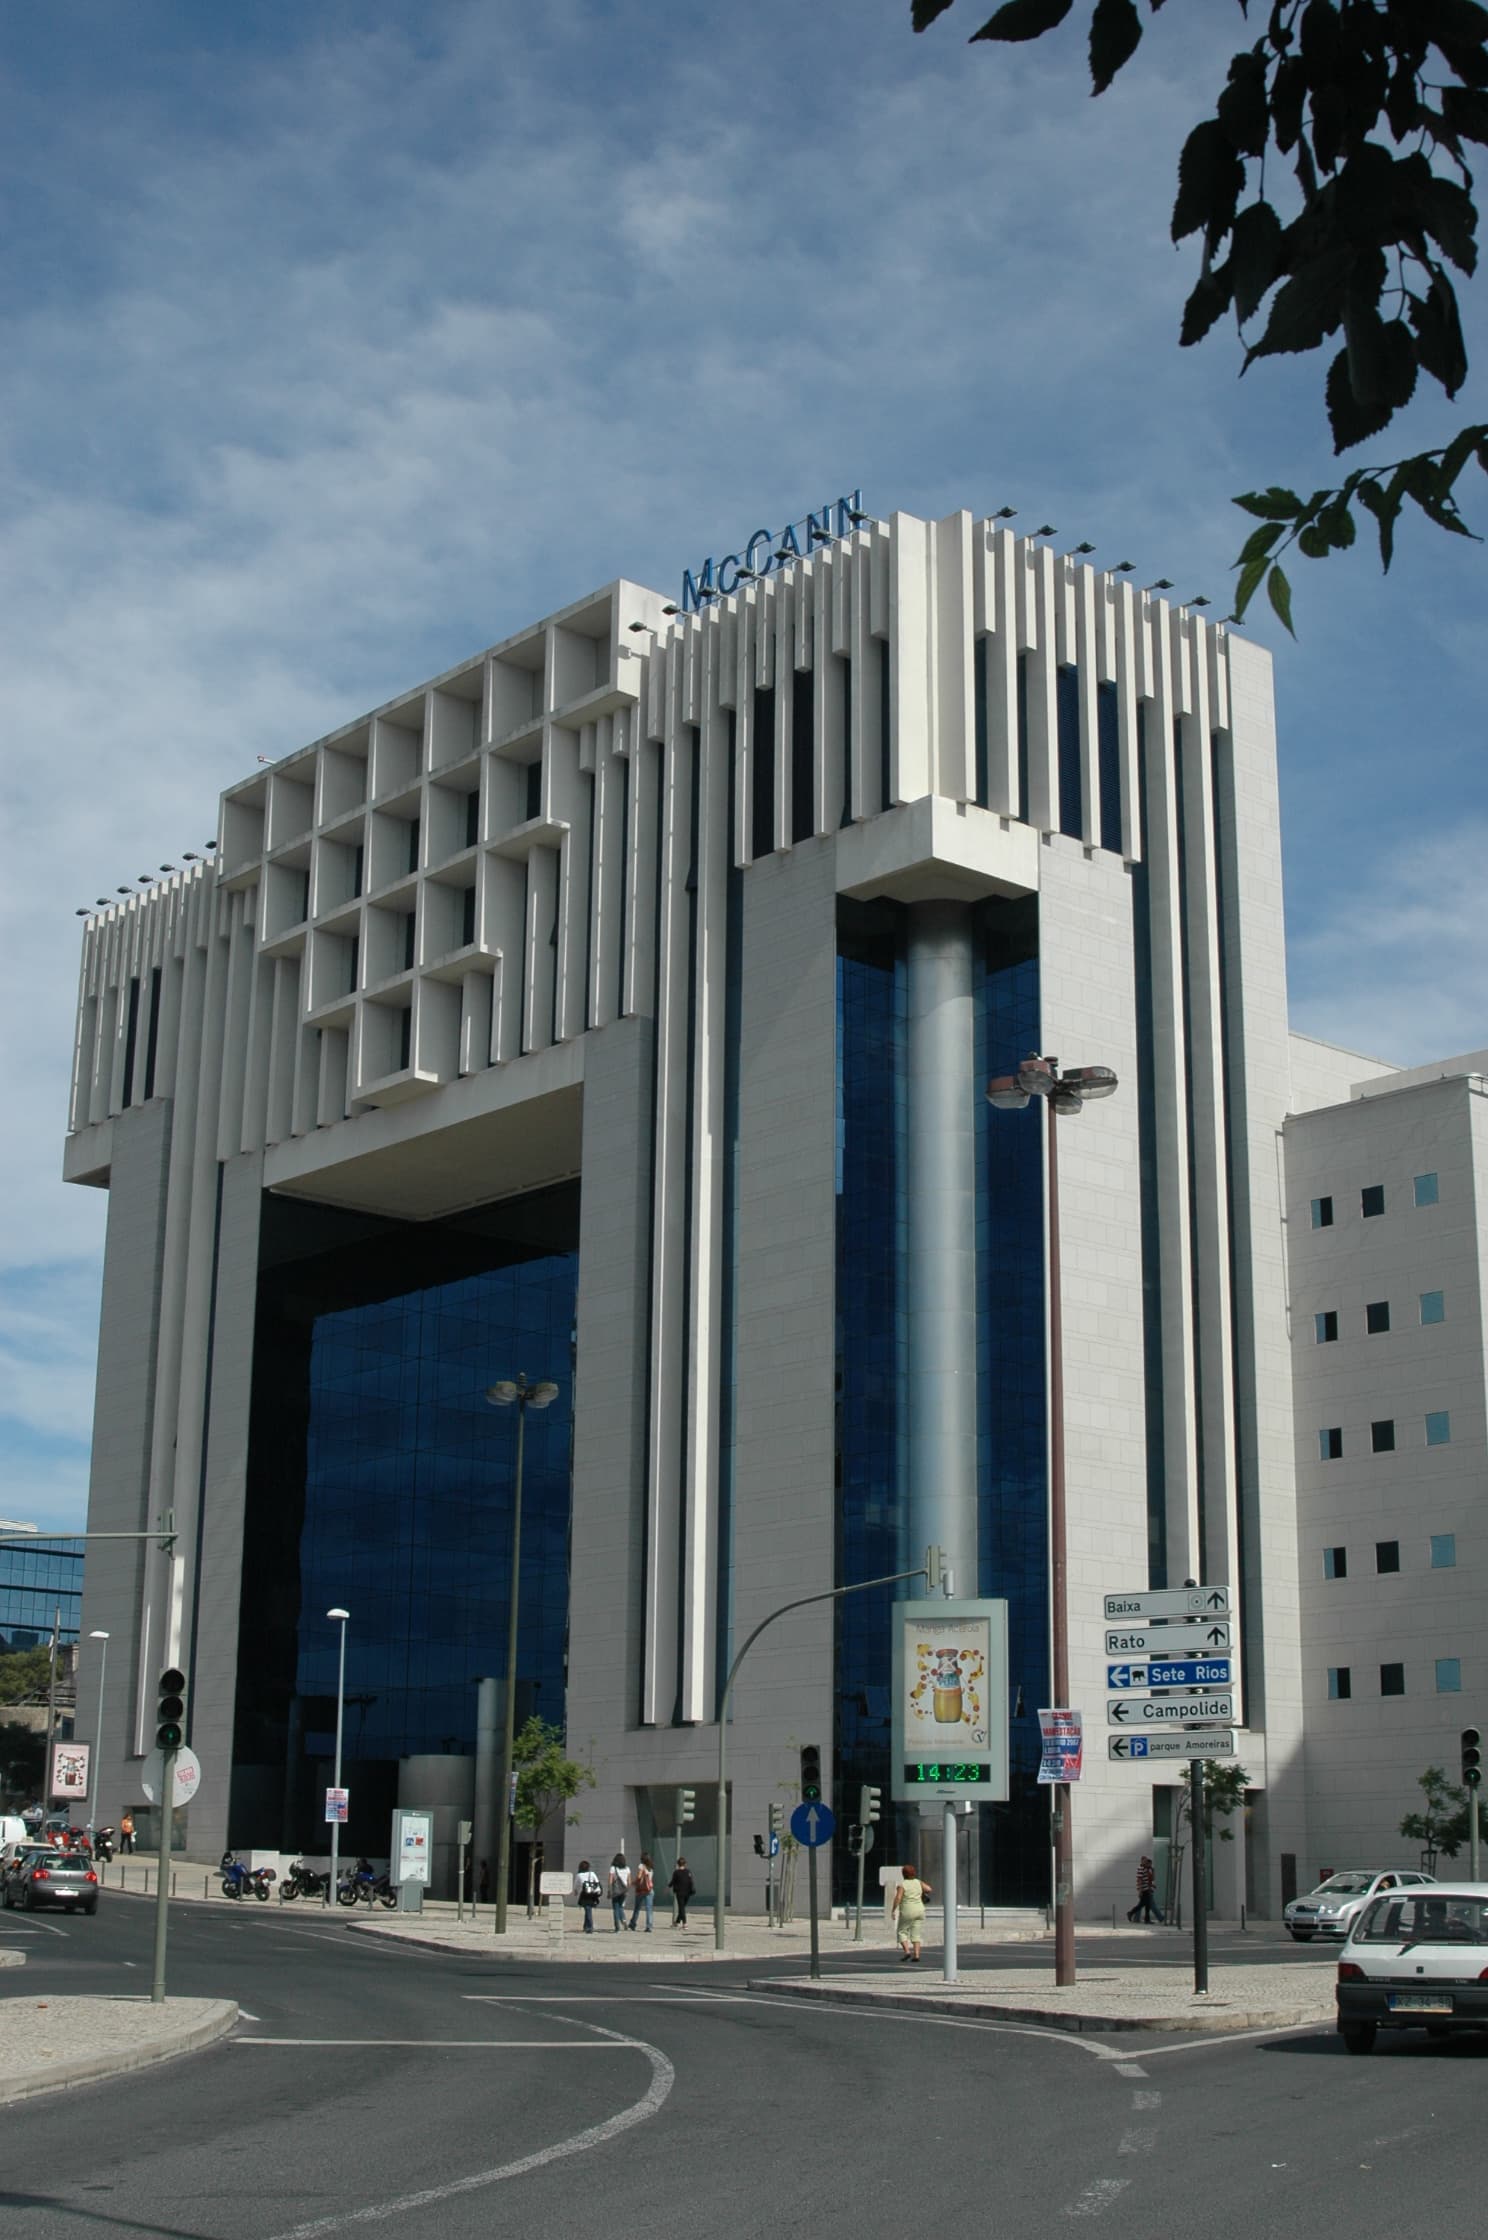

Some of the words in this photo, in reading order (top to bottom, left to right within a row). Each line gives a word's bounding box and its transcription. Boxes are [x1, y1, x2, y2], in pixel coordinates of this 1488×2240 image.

[1107, 1600, 1141, 1613] Baixa
[1108, 1635, 1145, 1649] Rato
[1151, 1667, 1186, 1681] Sete
[1195, 1665, 1228, 1680] Rios
[1143, 1701, 1229, 1719] Campolide
[1150, 1742, 1181, 1752] parque
[1185, 1740, 1231, 1750] Amoreiras
[916, 1762, 980, 1781] 14:23
